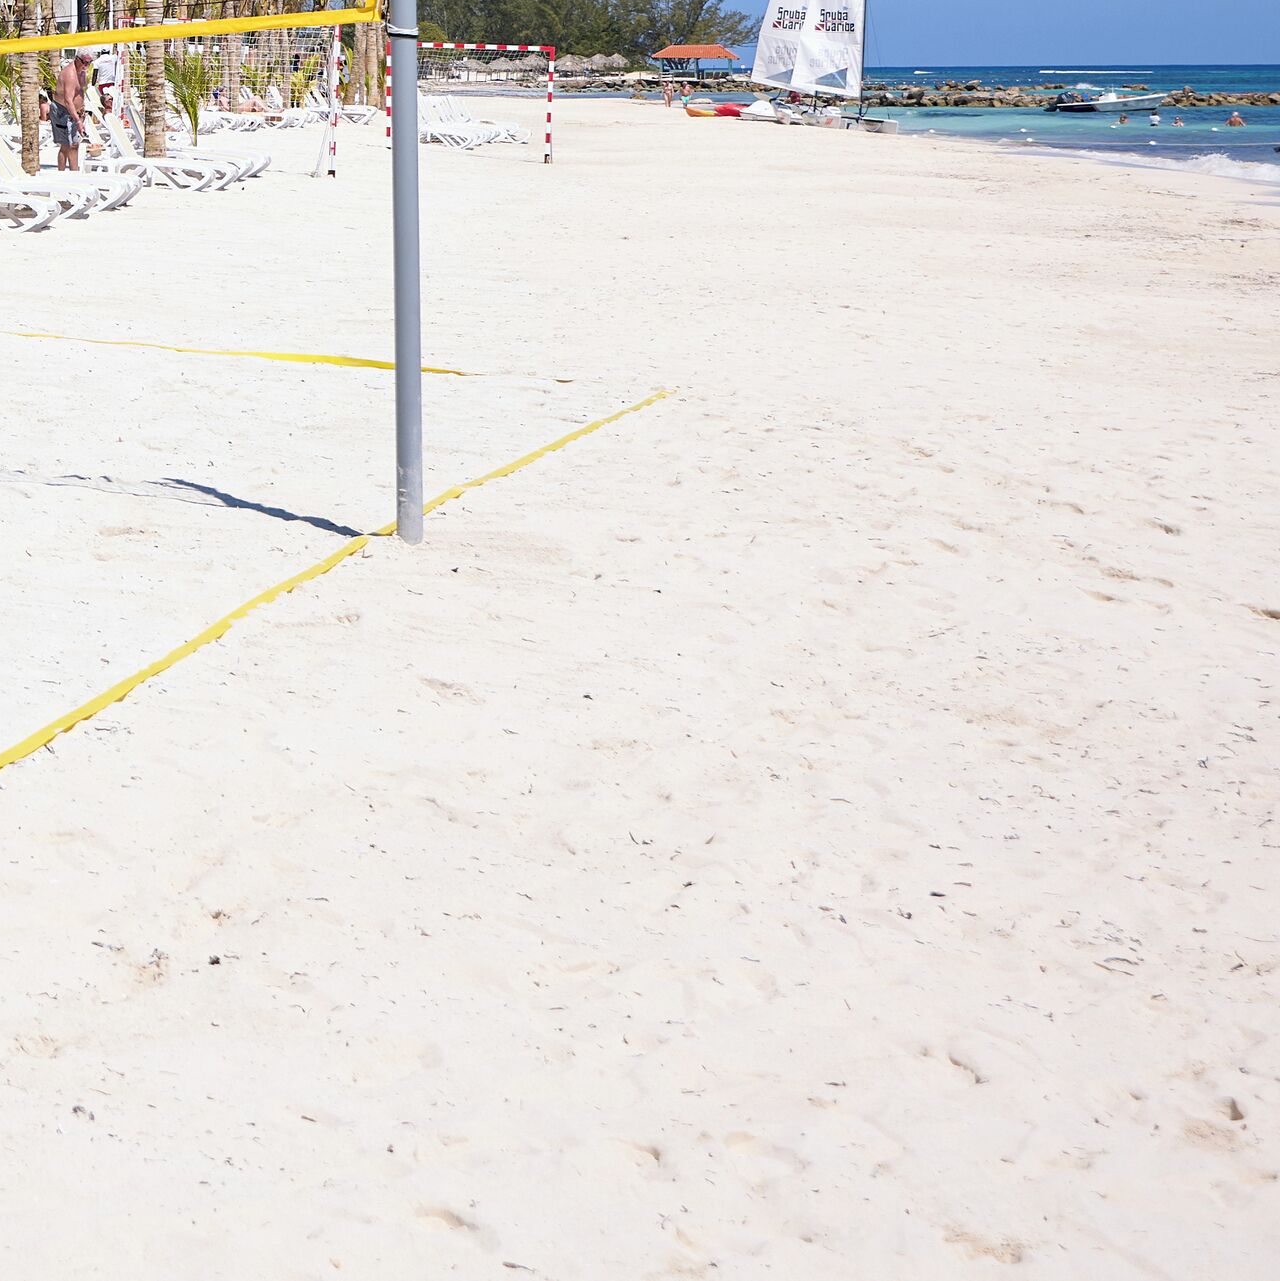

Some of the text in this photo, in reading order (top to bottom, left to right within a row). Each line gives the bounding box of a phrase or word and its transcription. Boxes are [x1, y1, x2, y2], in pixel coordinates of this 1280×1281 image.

[777, 7, 806, 20] Scuba
[820, 8, 848, 23] Scuba
[825, 21, 855, 32] Caribe
